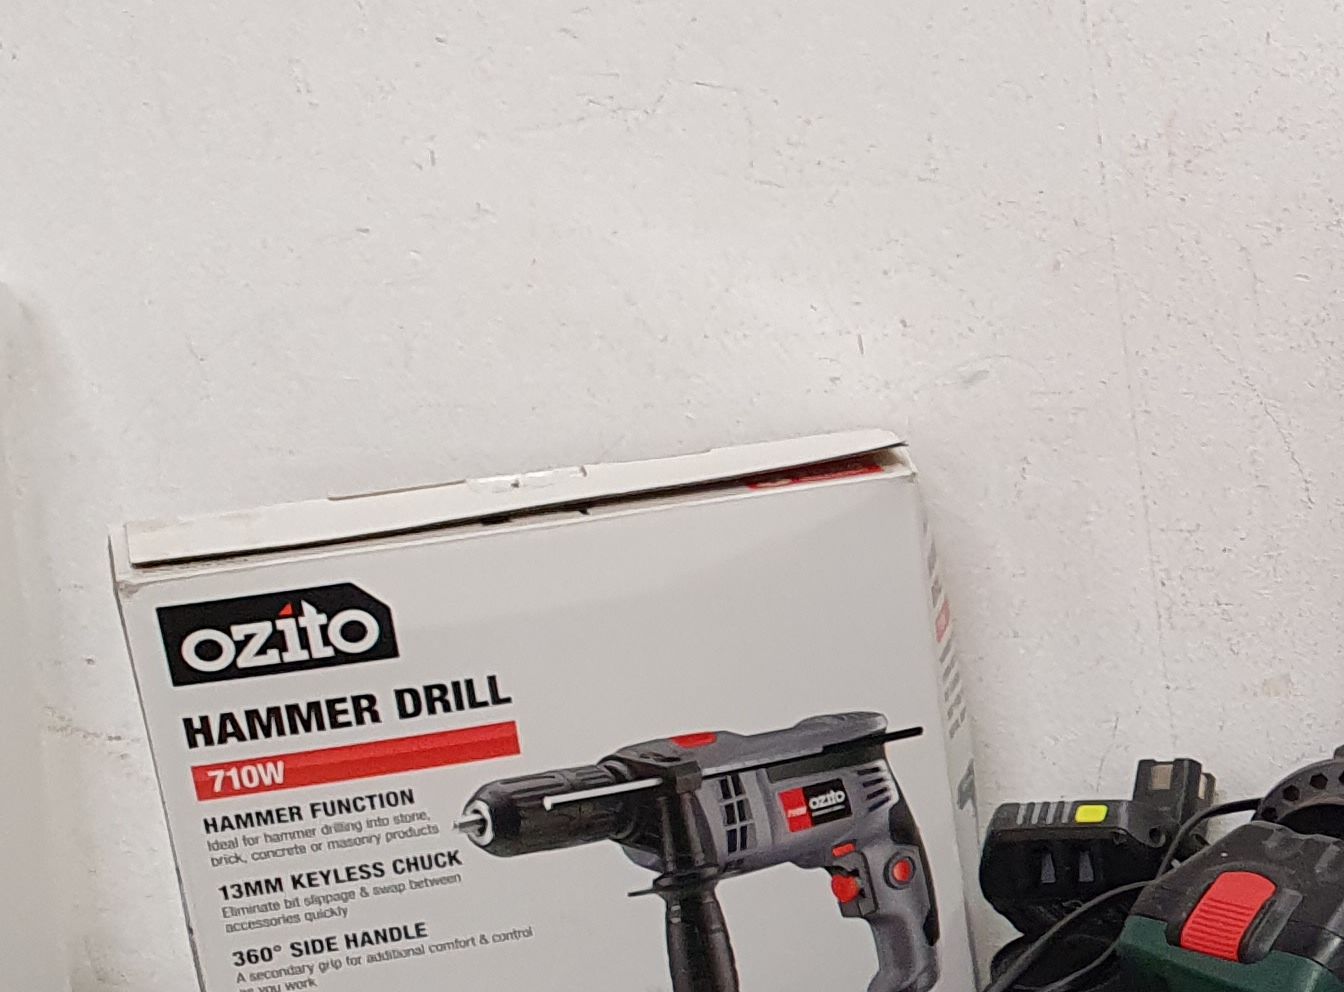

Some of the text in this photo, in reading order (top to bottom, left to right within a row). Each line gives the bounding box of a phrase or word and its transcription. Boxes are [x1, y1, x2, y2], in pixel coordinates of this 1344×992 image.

[181, 600, 380, 672] ozito
[183, 675, 512, 749] HAMMER DRILL
[208, 761, 284, 793] 710W
[809, 790, 845, 809] ozito
[203, 789, 414, 833] HAMMER FUNCTION
[207, 809, 431, 852] Ideal for hammer drilling into stone,
[211, 823, 440, 868] brick, concrete or masonry products
[218, 850, 463, 901] 13MM KEYLESS CHUCK
[222, 872, 462, 919] Eliminate bit slippage & swap between
[225, 906, 348, 934] accessories quickly
[232, 922, 428, 967] 360° SIDE HANDLE
[235, 926, 533, 984] A secondary grip for additional comfort & control
[285, 976, 318, 992] work
